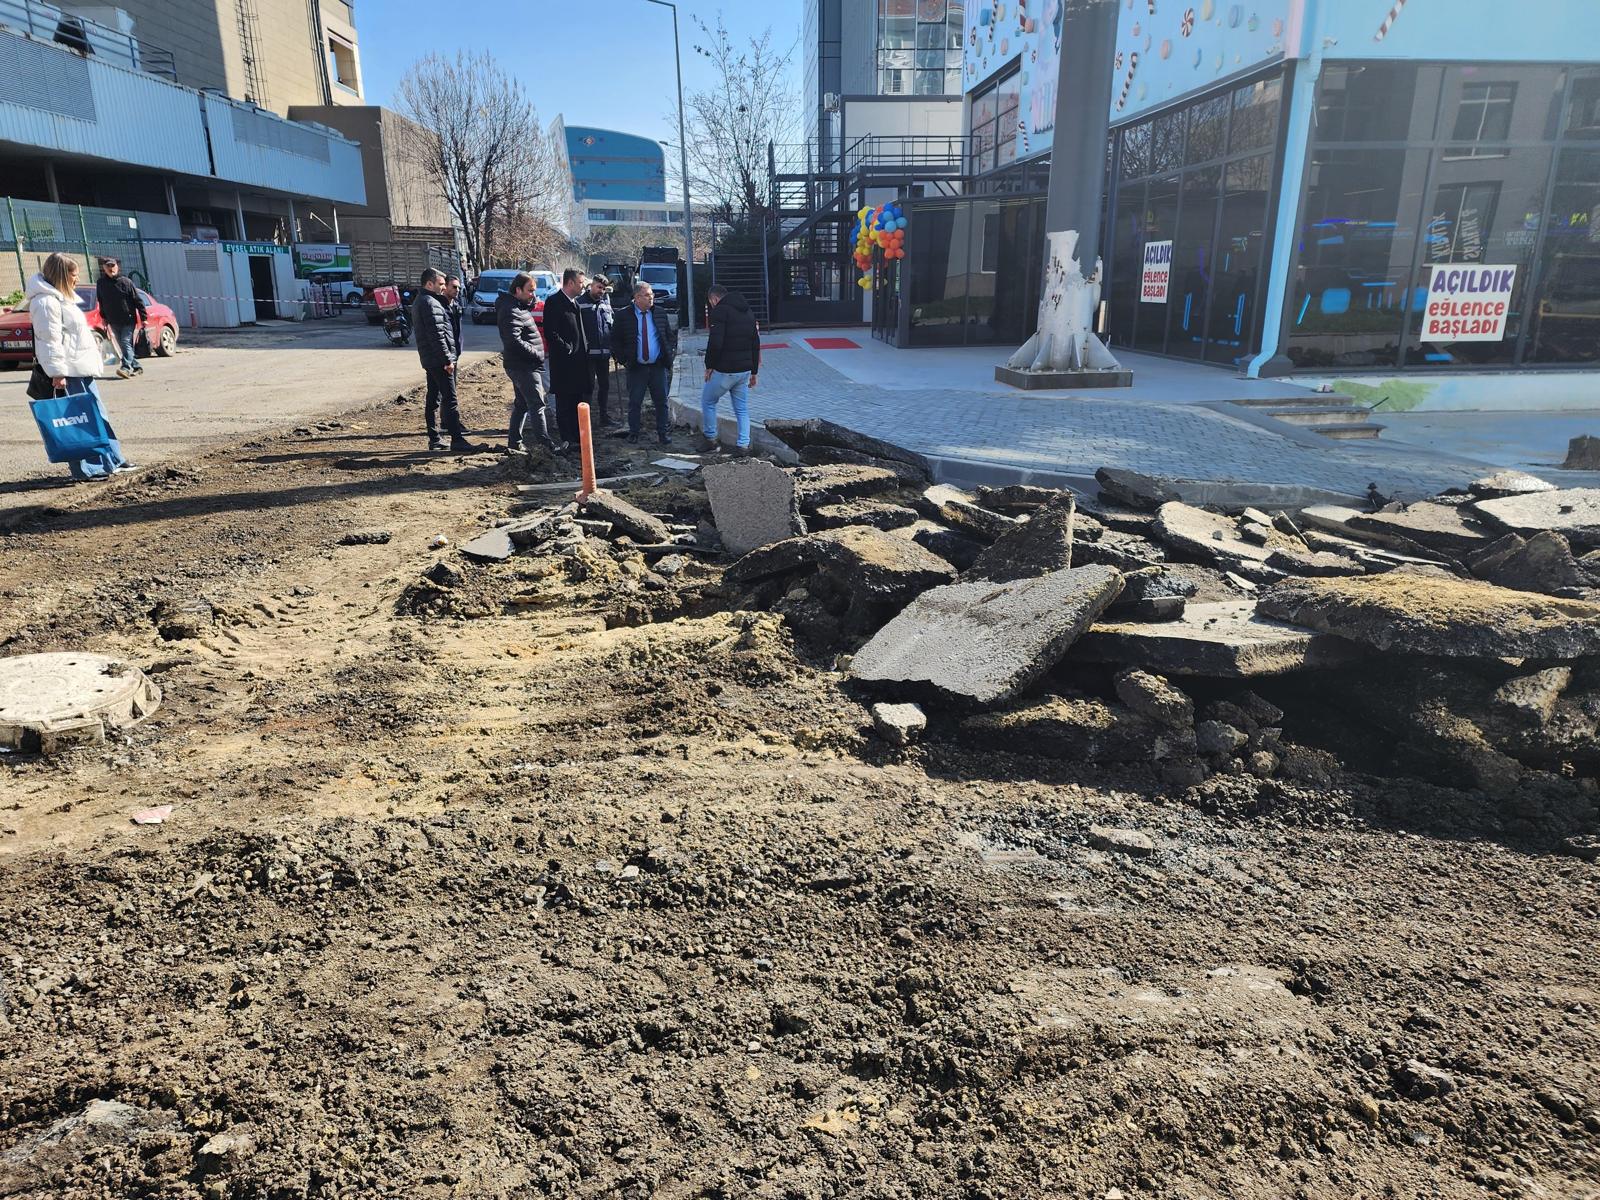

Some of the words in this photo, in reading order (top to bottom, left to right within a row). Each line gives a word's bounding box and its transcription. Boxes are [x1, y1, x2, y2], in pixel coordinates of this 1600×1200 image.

[226, 244, 248, 253] EVSEL
[249, 245, 265, 253] ATIK
[265, 246, 284, 254] ALANI
[1145, 245, 1171, 265] AÇILDIK
[1432, 270, 1514, 295] AÇILDIK
[380, 291, 389, 304] Y
[52, 412, 89, 428] mavi
